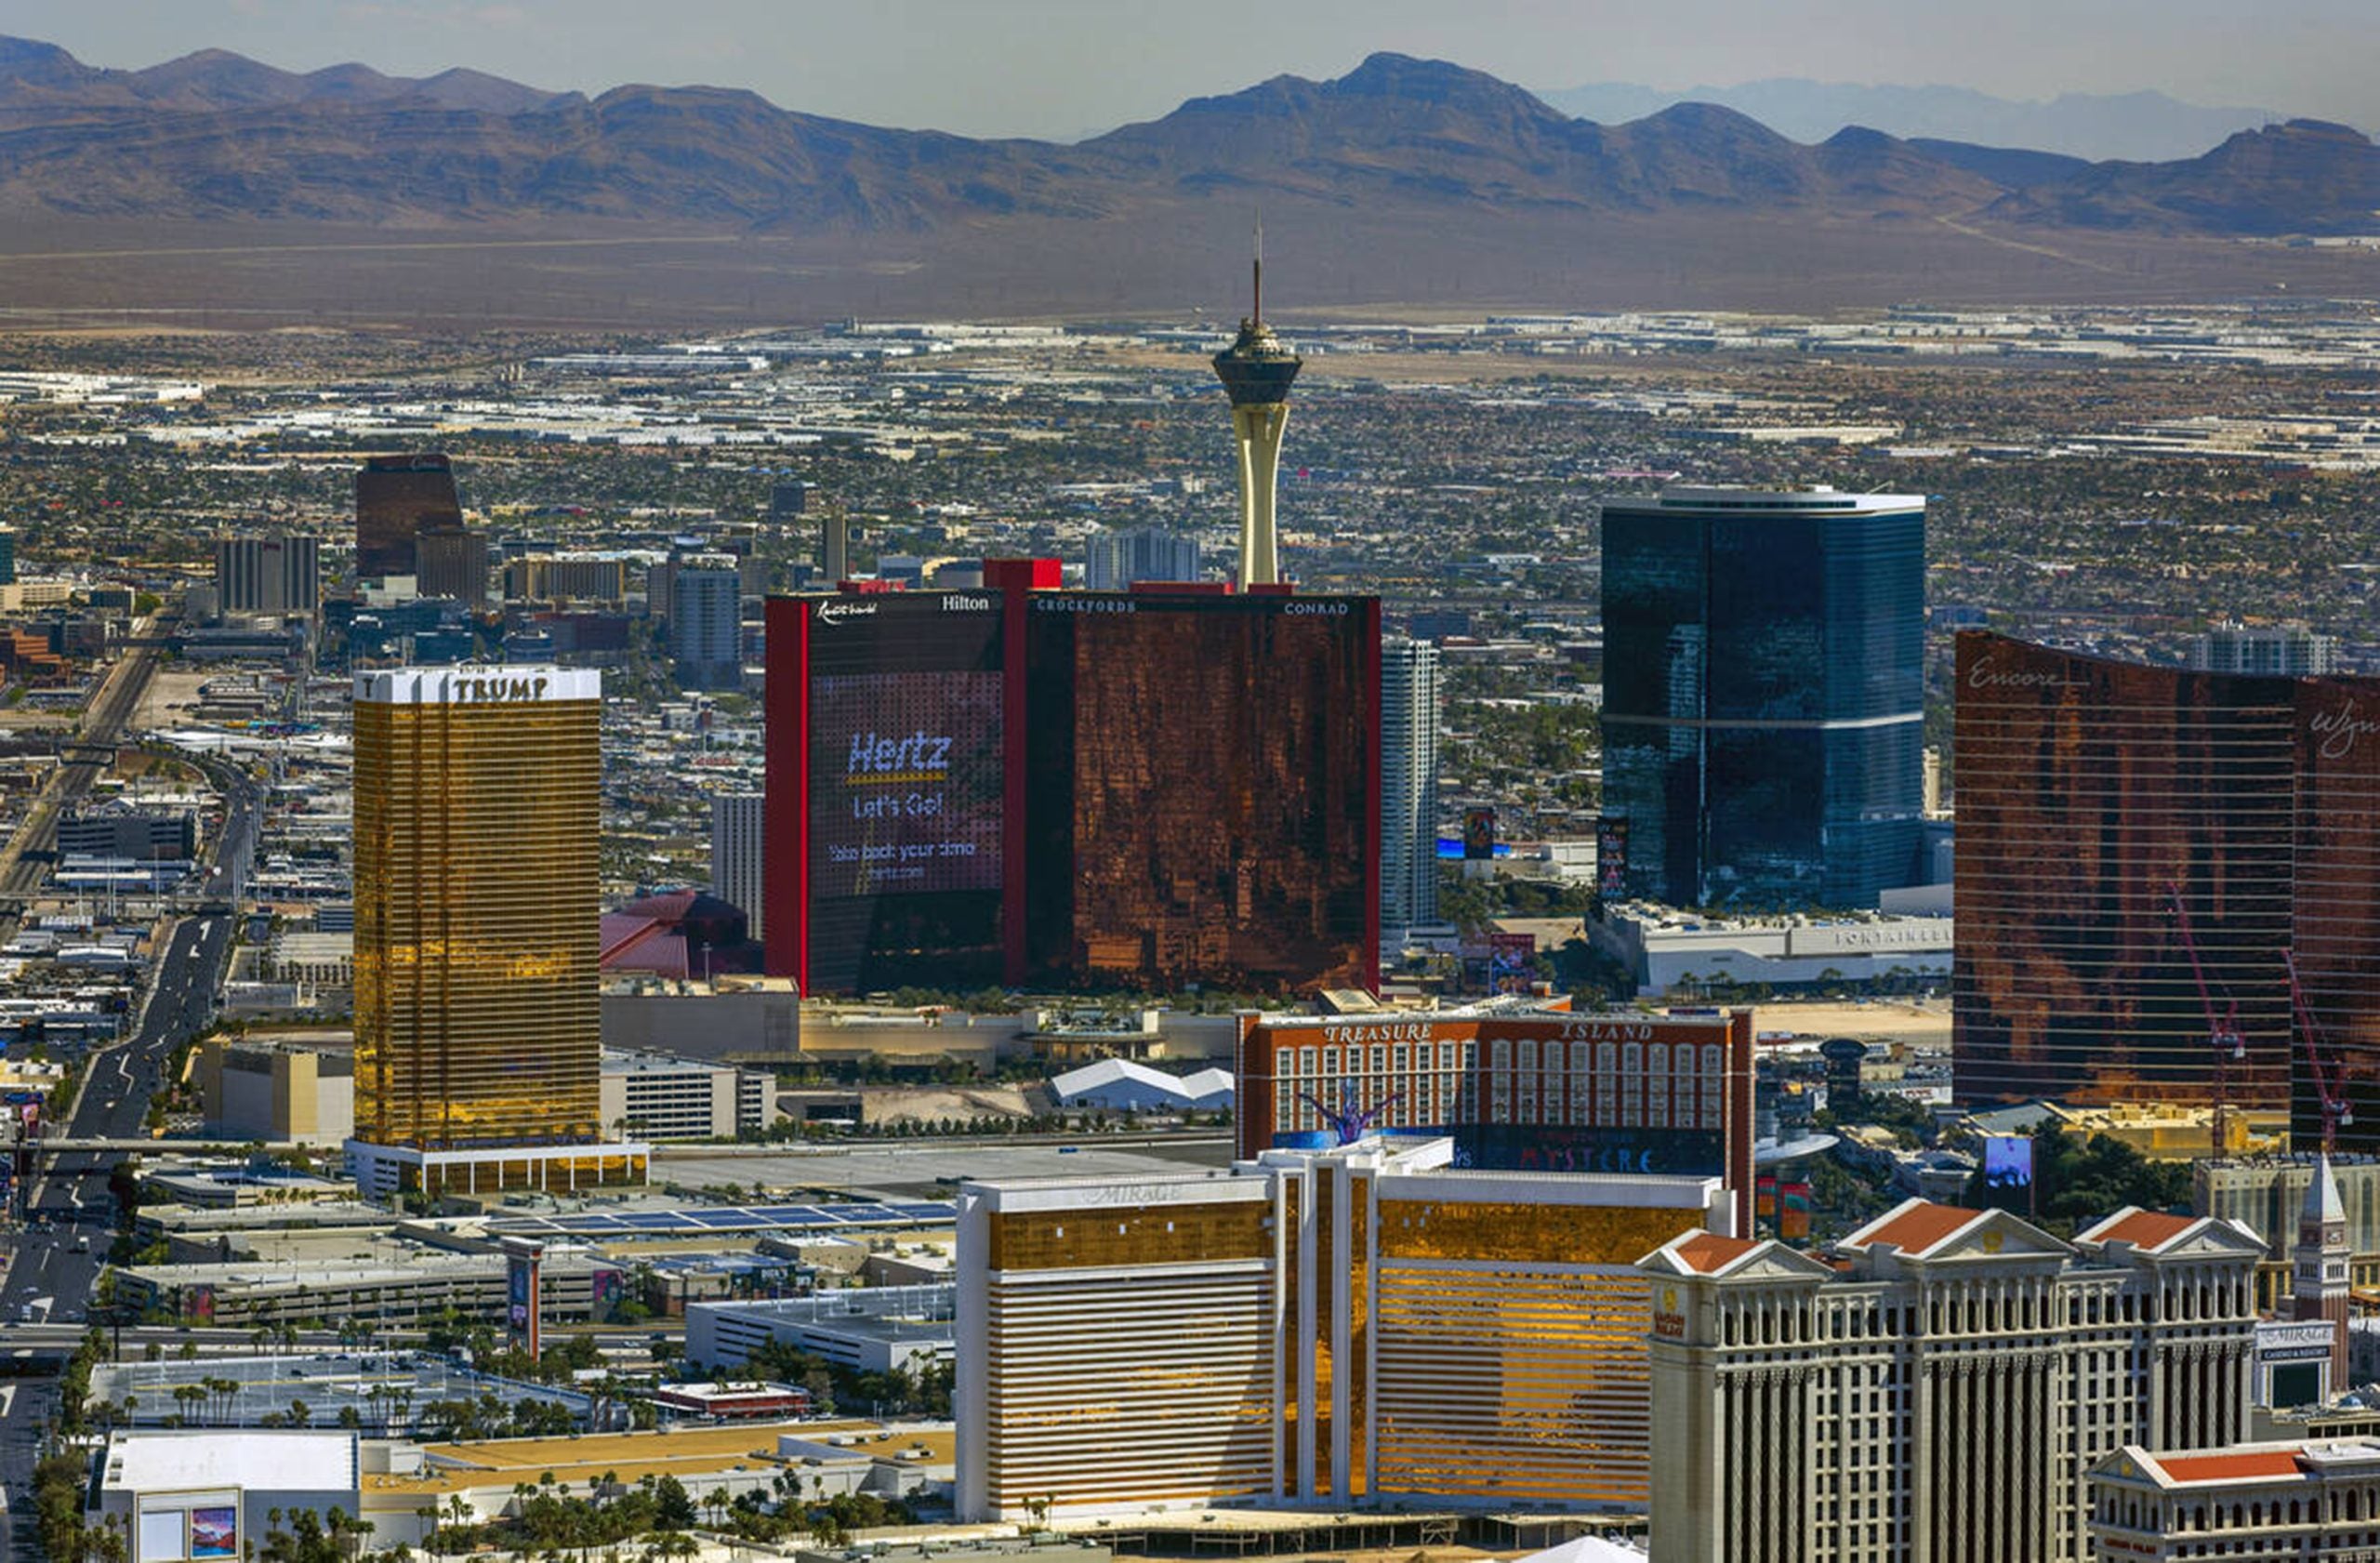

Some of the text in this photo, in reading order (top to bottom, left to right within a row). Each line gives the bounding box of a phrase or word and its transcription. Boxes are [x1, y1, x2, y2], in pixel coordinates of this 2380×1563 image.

[942, 595, 989, 611] Hilton
[1037, 599, 1136, 614] CROCKFORDS
[1284, 603, 1349, 616] CONRAD
[1968, 656, 2091, 688] Encore
[453, 678, 549, 698] TRUMP
[2309, 697, 2380, 759] Wyn
[848, 730, 953, 773] Hertz
[853, 792, 943, 818] Let's Go!
[1324, 1021, 1653, 1043] TREASURE ISLAND
[2275, 1328, 2330, 1344] MIRAGE
